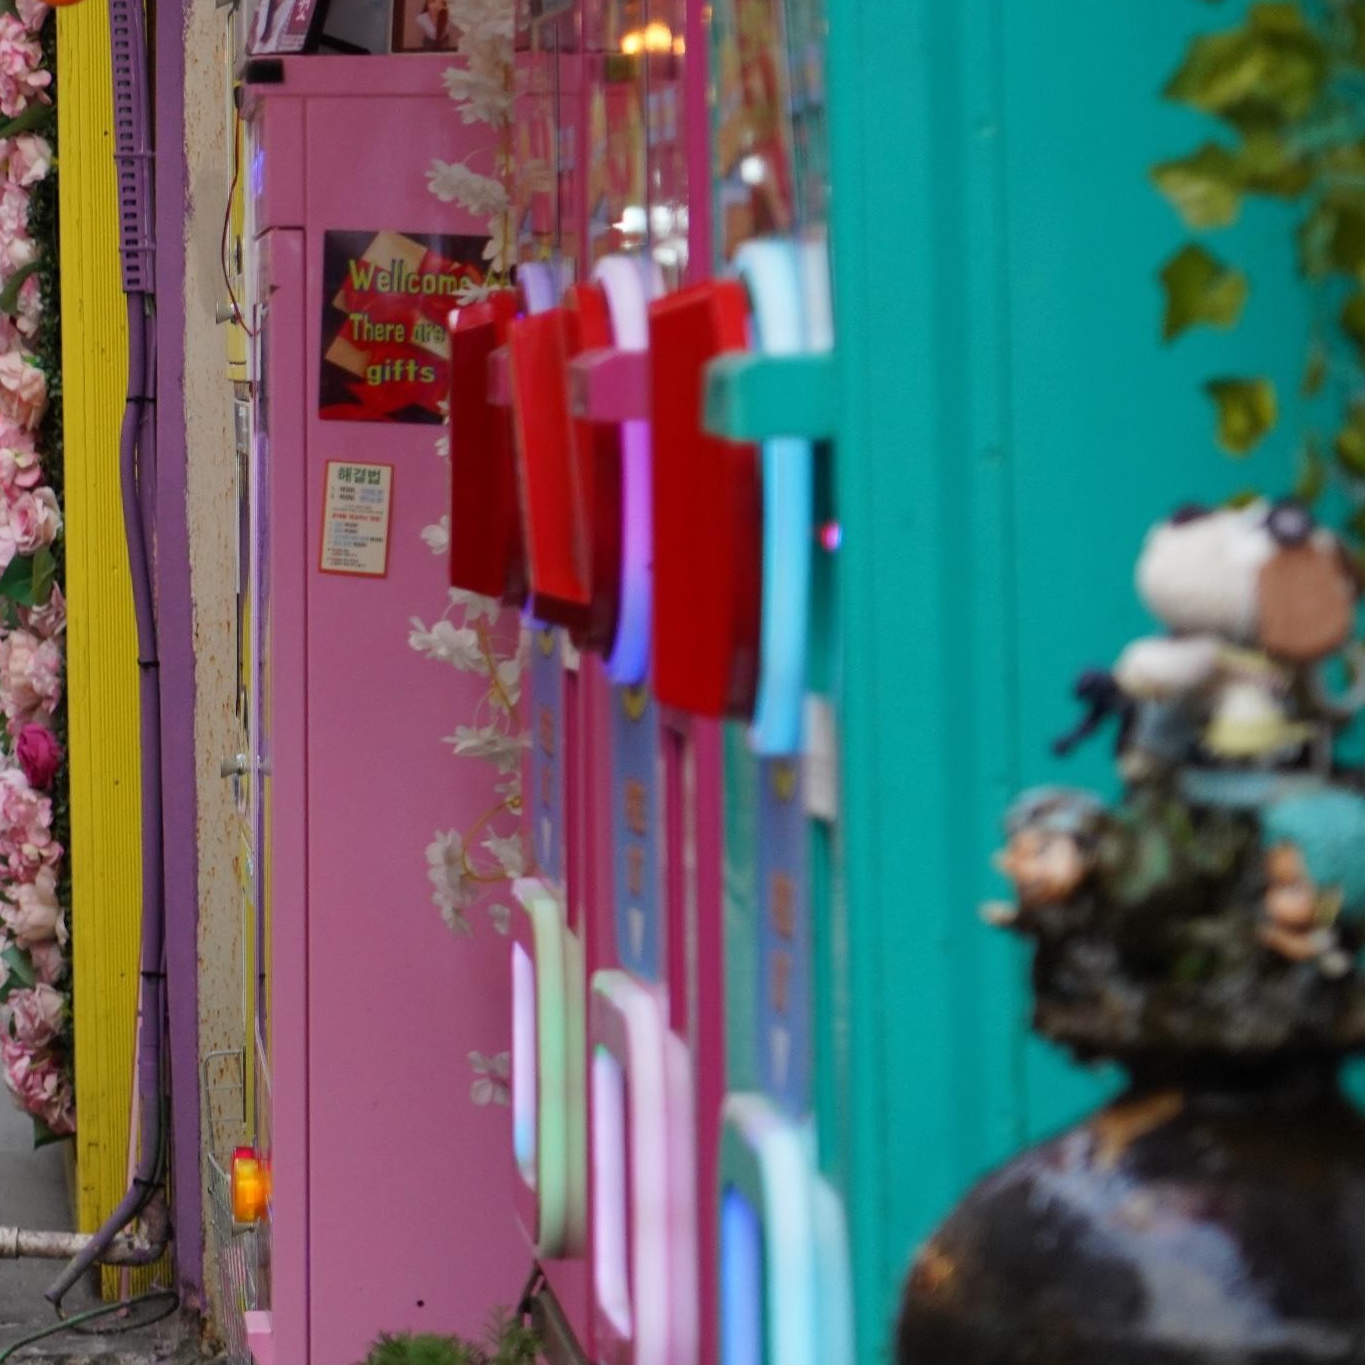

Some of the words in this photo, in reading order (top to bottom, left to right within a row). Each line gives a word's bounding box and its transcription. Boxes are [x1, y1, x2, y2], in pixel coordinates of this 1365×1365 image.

[348, 258, 470, 295] Wellcome
[349, 312, 405, 343] There
[413, 323, 446, 344] are
[367, 359, 436, 386] gifts
[338, 466, 382, 485] 해결법
